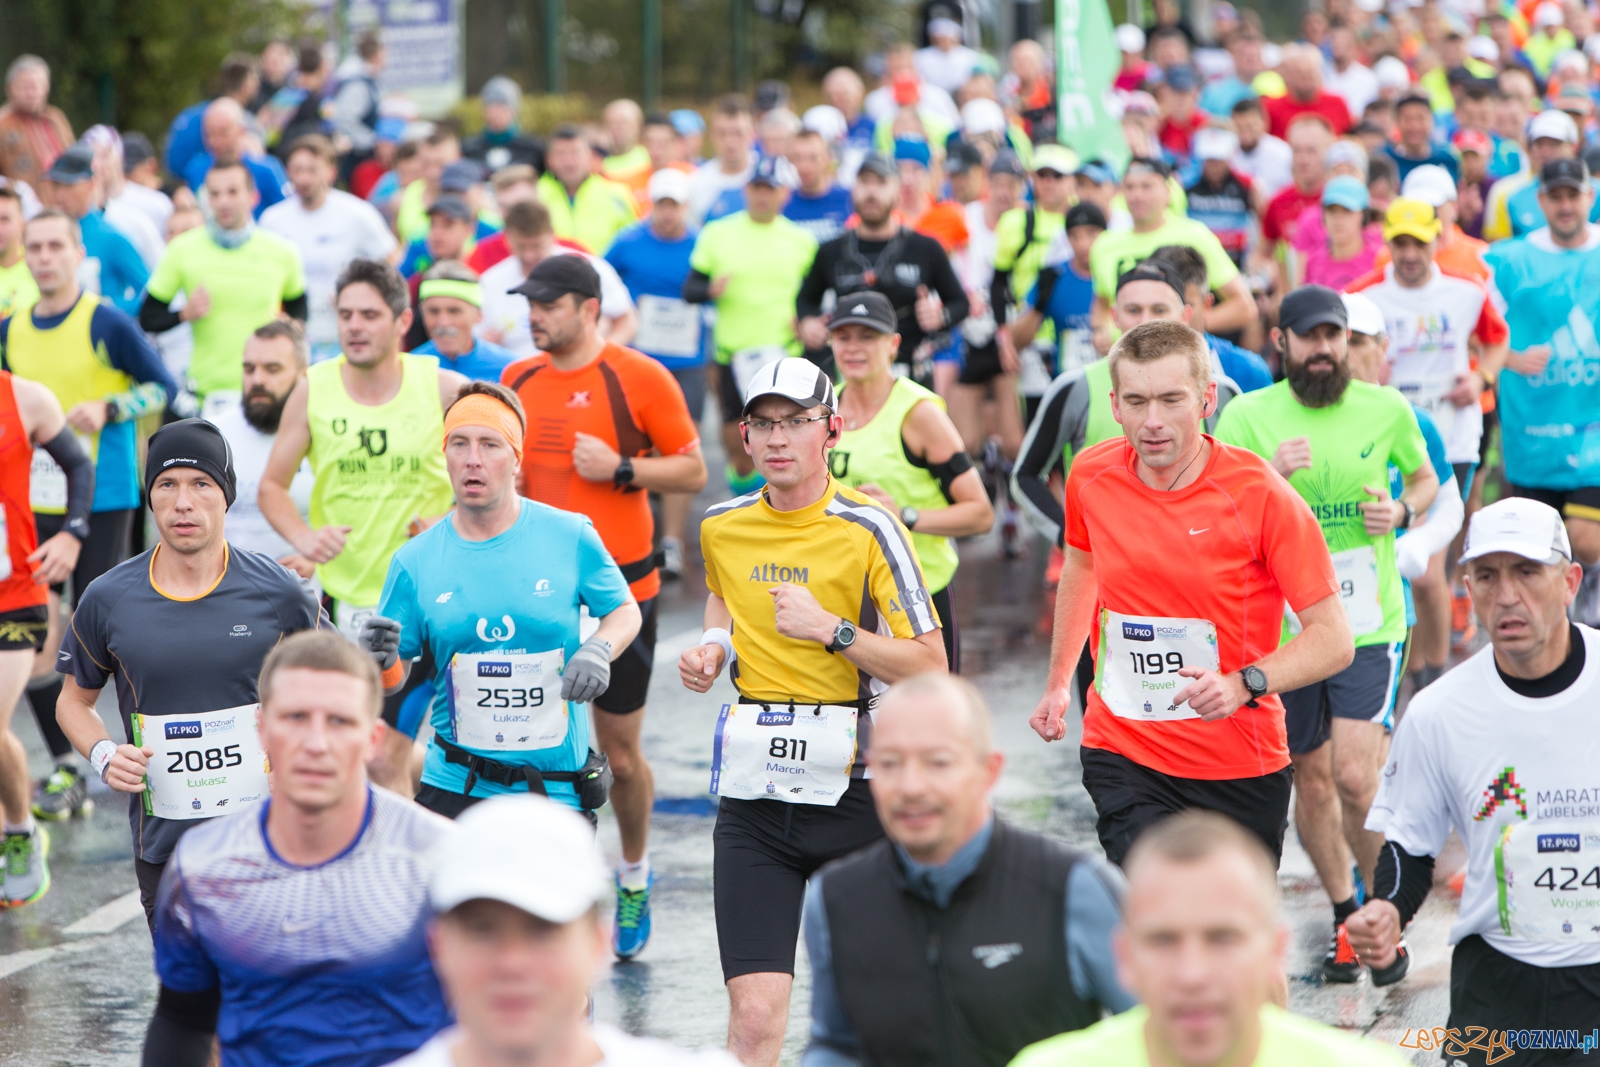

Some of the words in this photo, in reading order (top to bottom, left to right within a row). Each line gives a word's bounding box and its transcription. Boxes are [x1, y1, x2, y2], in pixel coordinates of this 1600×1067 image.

[338, 457, 367, 473] RUN
[1124, 627, 1151, 637] 17.PKO
[1130, 652, 1184, 675] 1199
[480, 665, 509, 674] 17.PKO
[1142, 680, 1176, 690] Paweł
[477, 687, 544, 708] 2539
[493, 713, 530, 723] Łukasz
[761, 715, 792, 723] 17.PKO
[167, 725, 199, 735] 17.PKO
[769, 737, 807, 761] 811
[166, 744, 242, 773] 2085
[766, 763, 805, 774] Marcin
[187, 776, 227, 788] Łukasz
[1537, 805, 1600, 819] LUBELSKI
[1540, 838, 1578, 848] 17.PKO
